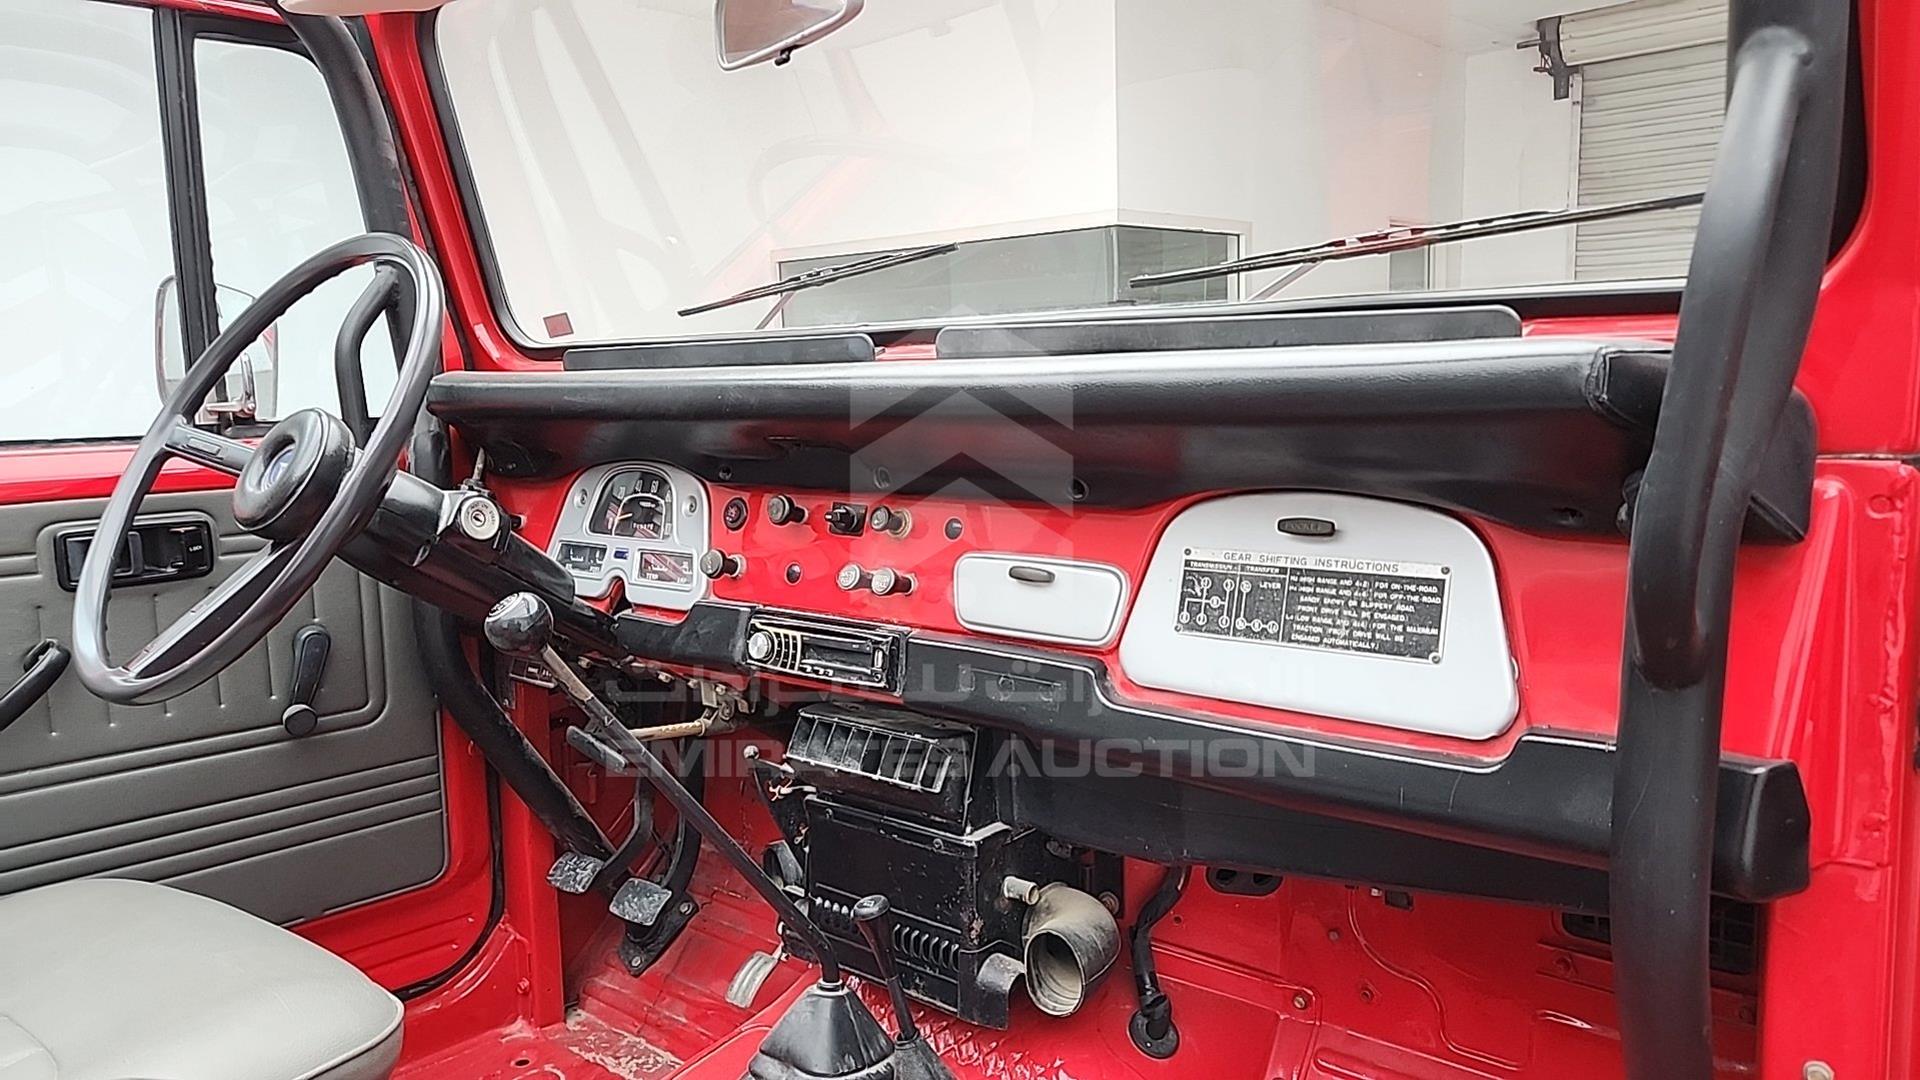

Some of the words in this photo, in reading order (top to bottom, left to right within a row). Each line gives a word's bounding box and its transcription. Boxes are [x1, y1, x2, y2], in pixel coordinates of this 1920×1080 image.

[1223, 552, 1252, 561] GEAR
[1259, 554, 1308, 567] SHIFTING
[1314, 557, 1399, 573] INSTRUCTIONS
[1259, 581, 1281, 589] LEVER
